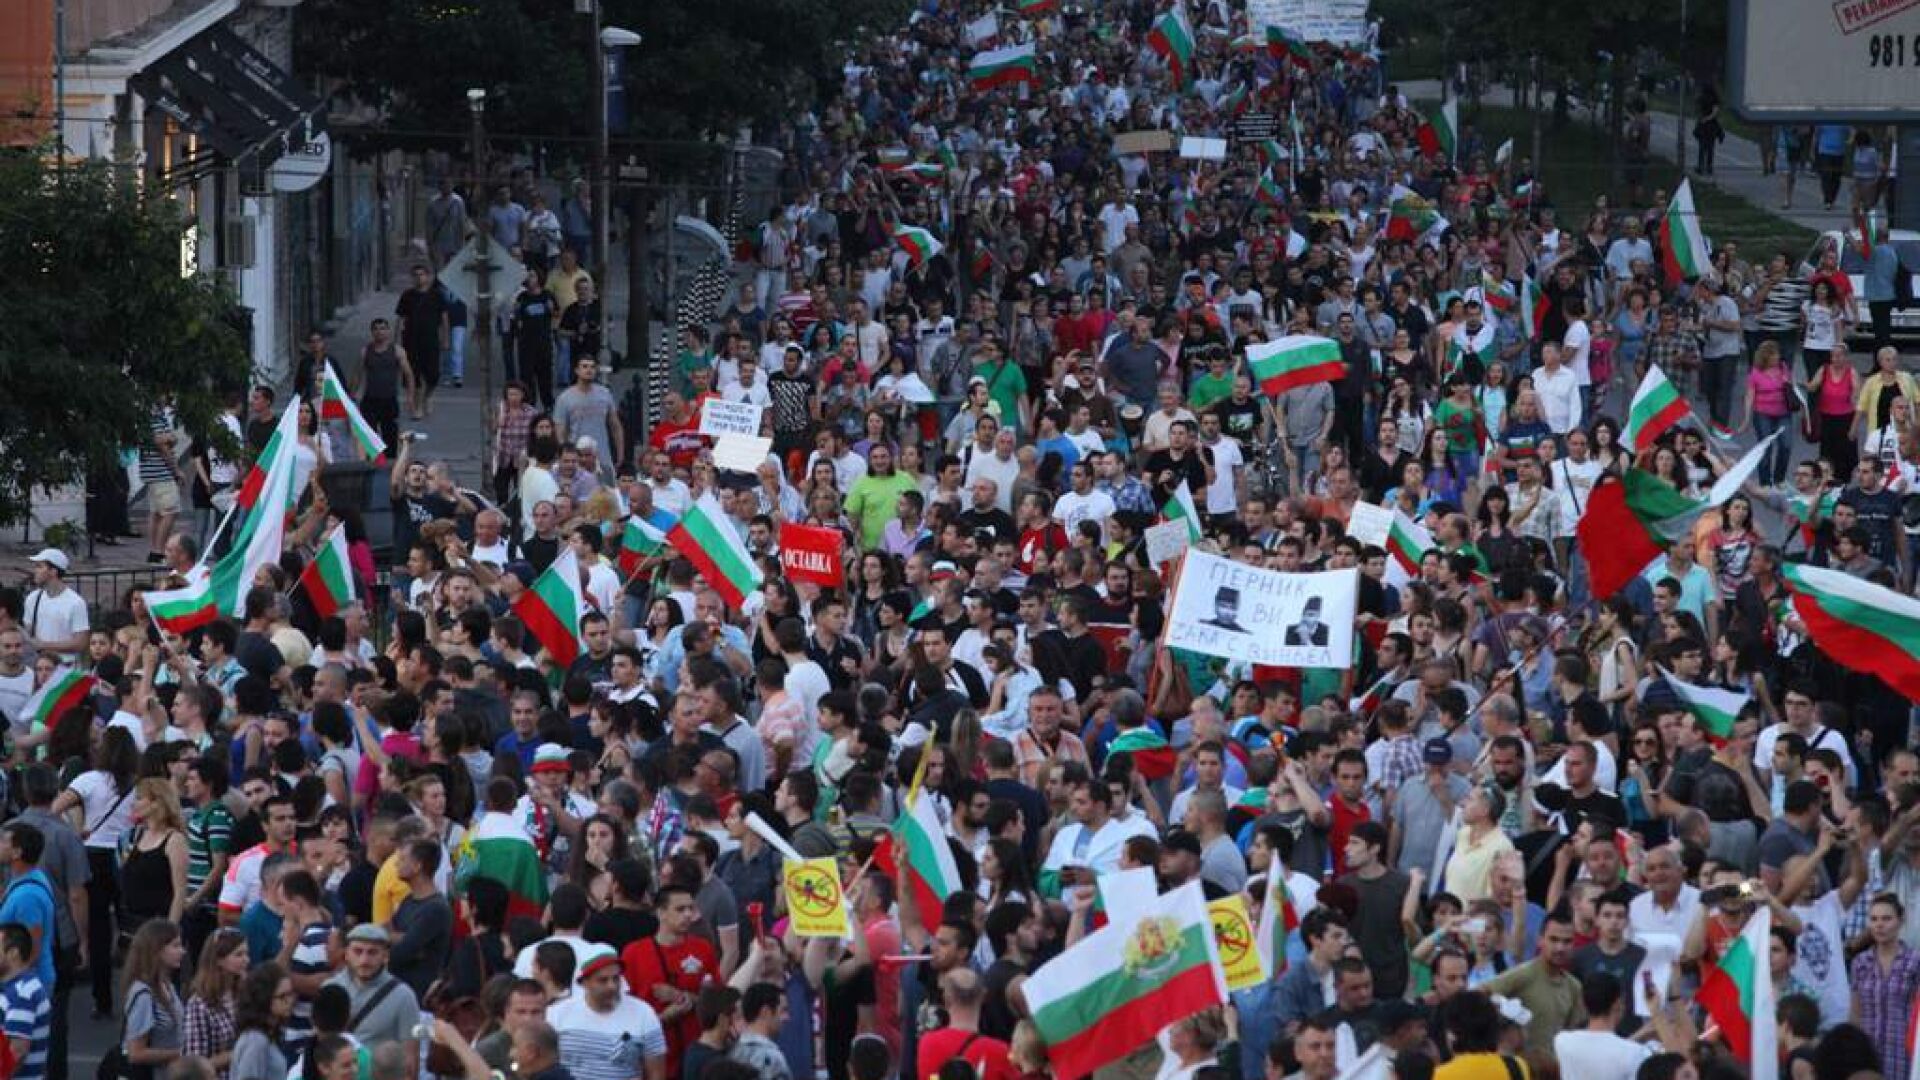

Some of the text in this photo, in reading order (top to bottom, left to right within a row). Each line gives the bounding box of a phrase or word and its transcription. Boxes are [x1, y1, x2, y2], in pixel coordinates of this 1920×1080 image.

[1869, 34, 1904, 68] 981
[784, 547, 832, 575] ОСТАВКА
[1209, 560, 1310, 597] ПЕРНИК
